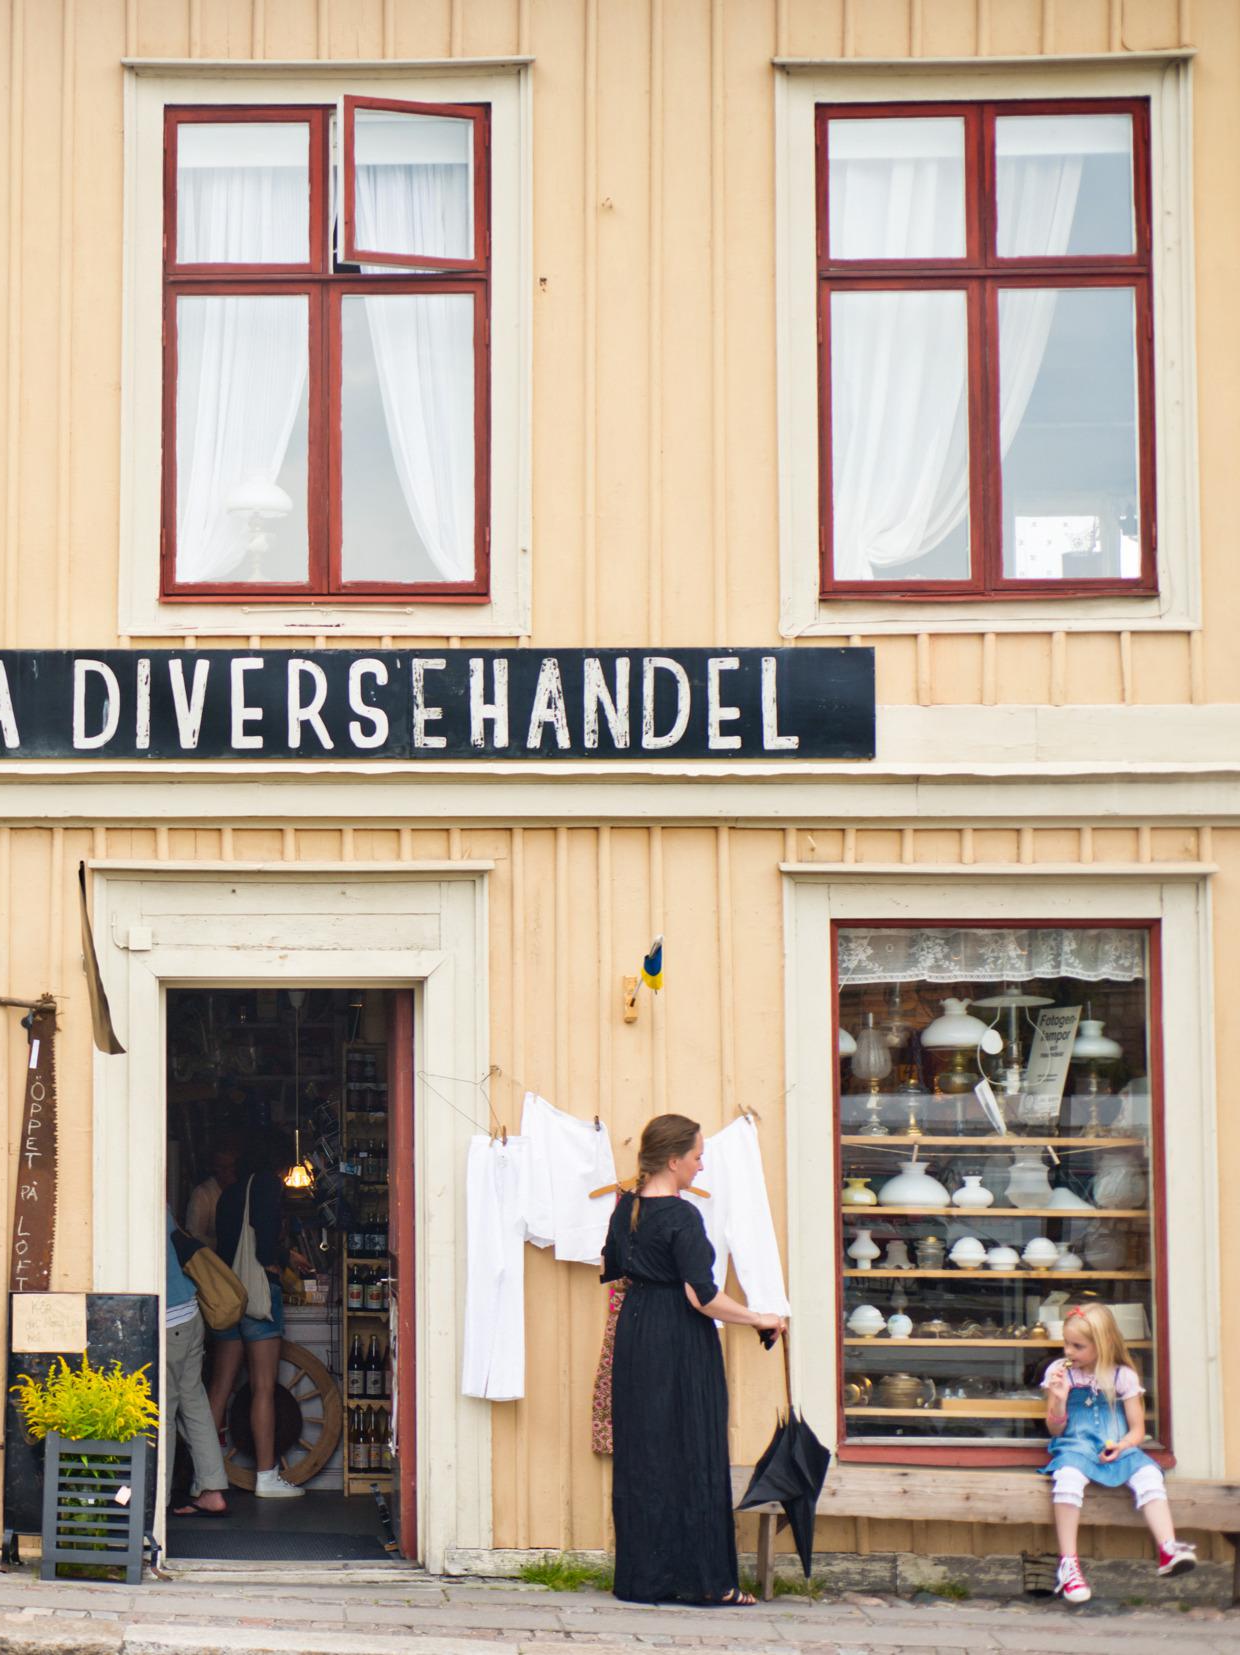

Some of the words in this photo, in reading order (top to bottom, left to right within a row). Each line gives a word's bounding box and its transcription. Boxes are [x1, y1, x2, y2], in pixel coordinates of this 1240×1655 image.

[73, 657, 800, 749] DIVERSEHANDEL
[24, 1075, 46, 1169] ÖPPET
[20, 1181, 38, 1201] PÅ
